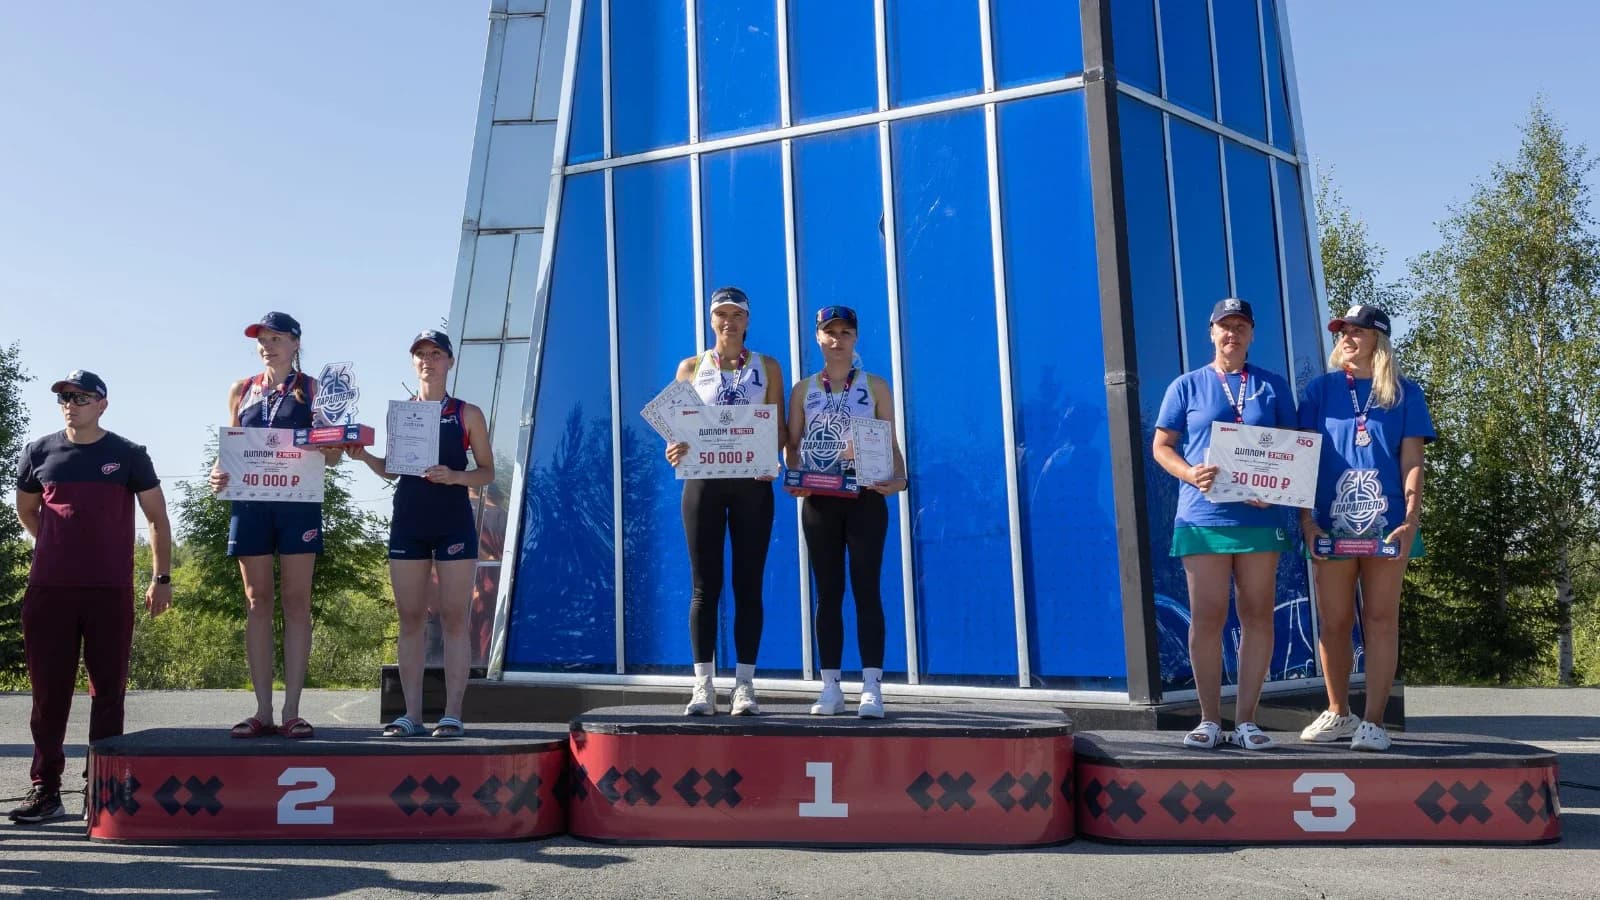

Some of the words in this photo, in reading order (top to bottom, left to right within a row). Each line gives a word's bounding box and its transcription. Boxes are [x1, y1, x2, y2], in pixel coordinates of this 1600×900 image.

[752, 369, 763, 387] 1
[856, 388, 869, 405] 2
[332, 414, 337, 422] 2
[699, 428, 728, 436] ДИПЛОМ
[802, 441, 847, 450] ПАРАЛЛЕЛЬ
[1234, 447, 1265, 458] ДИПЛОМ
[243, 450, 274, 459] ДИПЛОМ
[699, 451, 715, 464] 50
[718, 451, 743, 464] 000
[242, 473, 259, 486] 40
[262, 474, 288, 487] 000
[1231, 471, 1248, 485] 30
[1251, 473, 1278, 489] 000
[1334, 499, 1384, 513] ПАРАЛЛЕЛЬ
[1356, 522, 1362, 531] 3
[276, 767, 336, 824] 2
[799, 762, 849, 818] 1
[1292, 772, 1356, 832] 3
